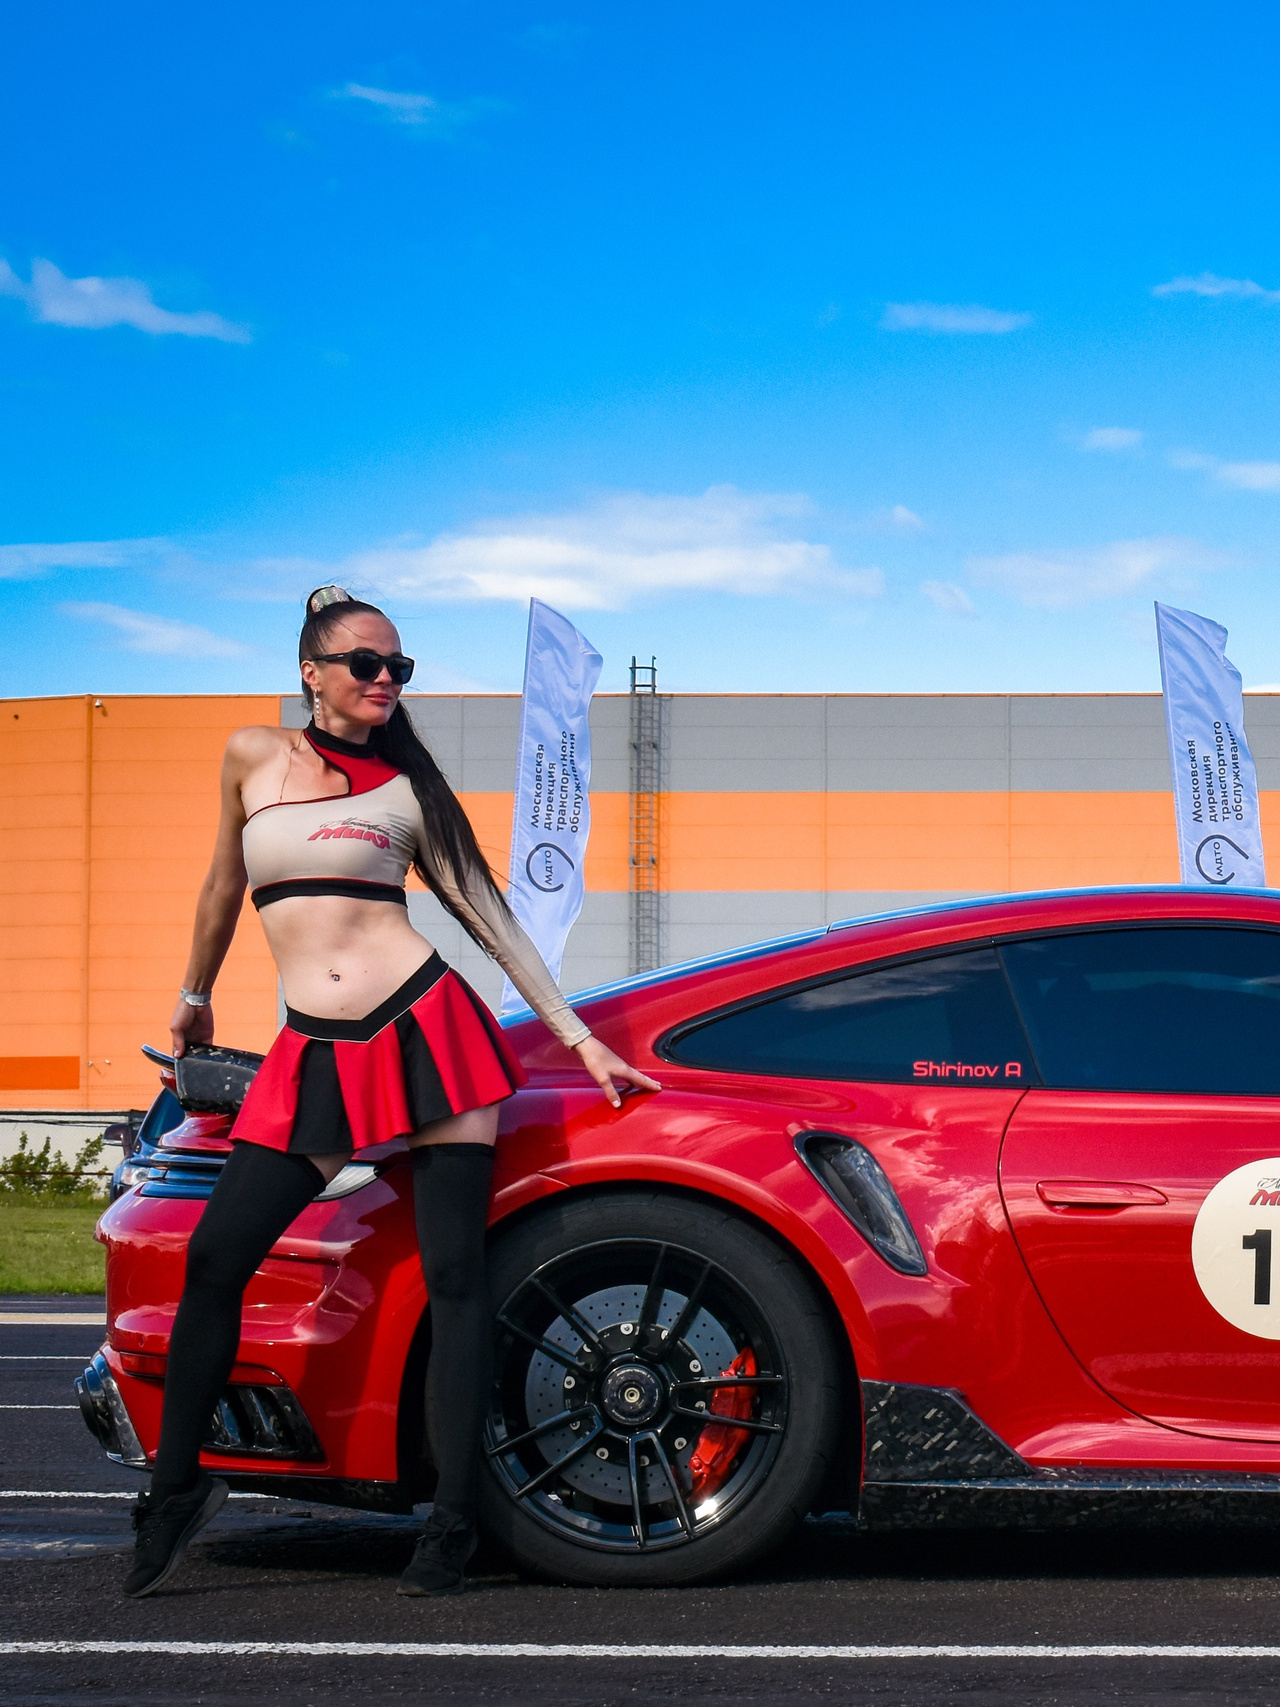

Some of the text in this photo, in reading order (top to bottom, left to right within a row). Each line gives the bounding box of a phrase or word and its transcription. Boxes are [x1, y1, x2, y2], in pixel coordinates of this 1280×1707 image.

[531, 744, 545, 828] Московская
[544, 762, 556, 831] дирекция
[556, 731, 571, 832] транспортного
[1188, 740, 1203, 823] Московская
[1203, 755, 1218, 823] дирекция
[1213, 721, 1231, 822] транспортного
[307, 826, 391, 850] Миля
[913, 1061, 1021, 1077] Shirinov A
